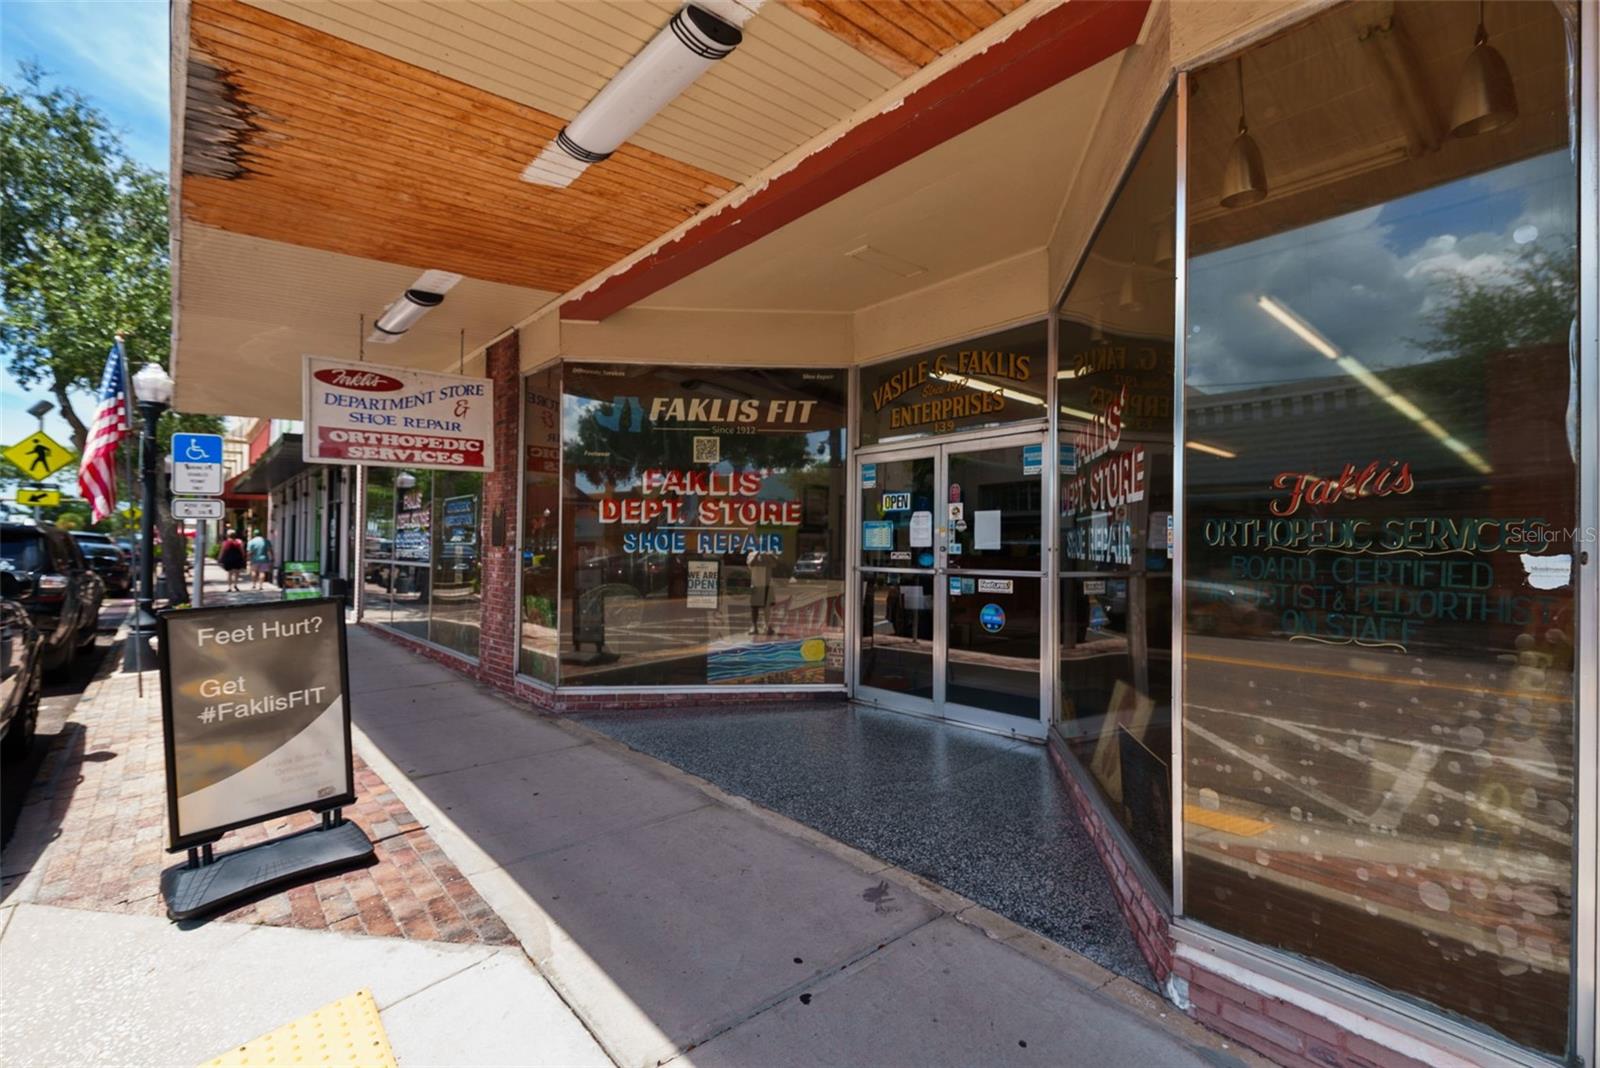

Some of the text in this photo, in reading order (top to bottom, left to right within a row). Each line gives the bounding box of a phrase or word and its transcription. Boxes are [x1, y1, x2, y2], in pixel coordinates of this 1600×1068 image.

[872, 361, 928, 411] VASILE
[958, 351, 1030, 381] FAKLIS
[324, 384, 484, 411] DEPARTMENT STORE
[454, 400, 471, 419] &
[890, 389, 1005, 430] ENTERPRISES
[349, 412, 462, 432] SHOE REPAIR
[650, 398, 818, 424] FAKLIS FIT
[712, 425, 756, 434] Since 1912
[934, 421, 955, 432] 139
[329, 431, 481, 451] ORTHOPEDIC
[348, 446, 465, 464] SERVICES
[1090, 446, 1144, 510] STORE
[1269, 460, 1413, 516] Faklis
[599, 499, 801, 525] DEPT. STORE
[884, 494, 909, 510] OPEN
[623, 531, 784, 555] SHOE REPAIR
[1088, 521, 1132, 565] REPAIR
[1202, 517, 1551, 553] ORTHOPEDIC SERVICES
[688, 571, 718, 579] WE ARE
[1231, 556, 1494, 590] BOARD CERTIFIED
[197, 616, 323, 647] Feet Hurt?
[1282, 609, 1424, 644] ON STAFF
[200, 676, 246, 698] Get
[197, 686, 326, 724] #FaklisFIT
